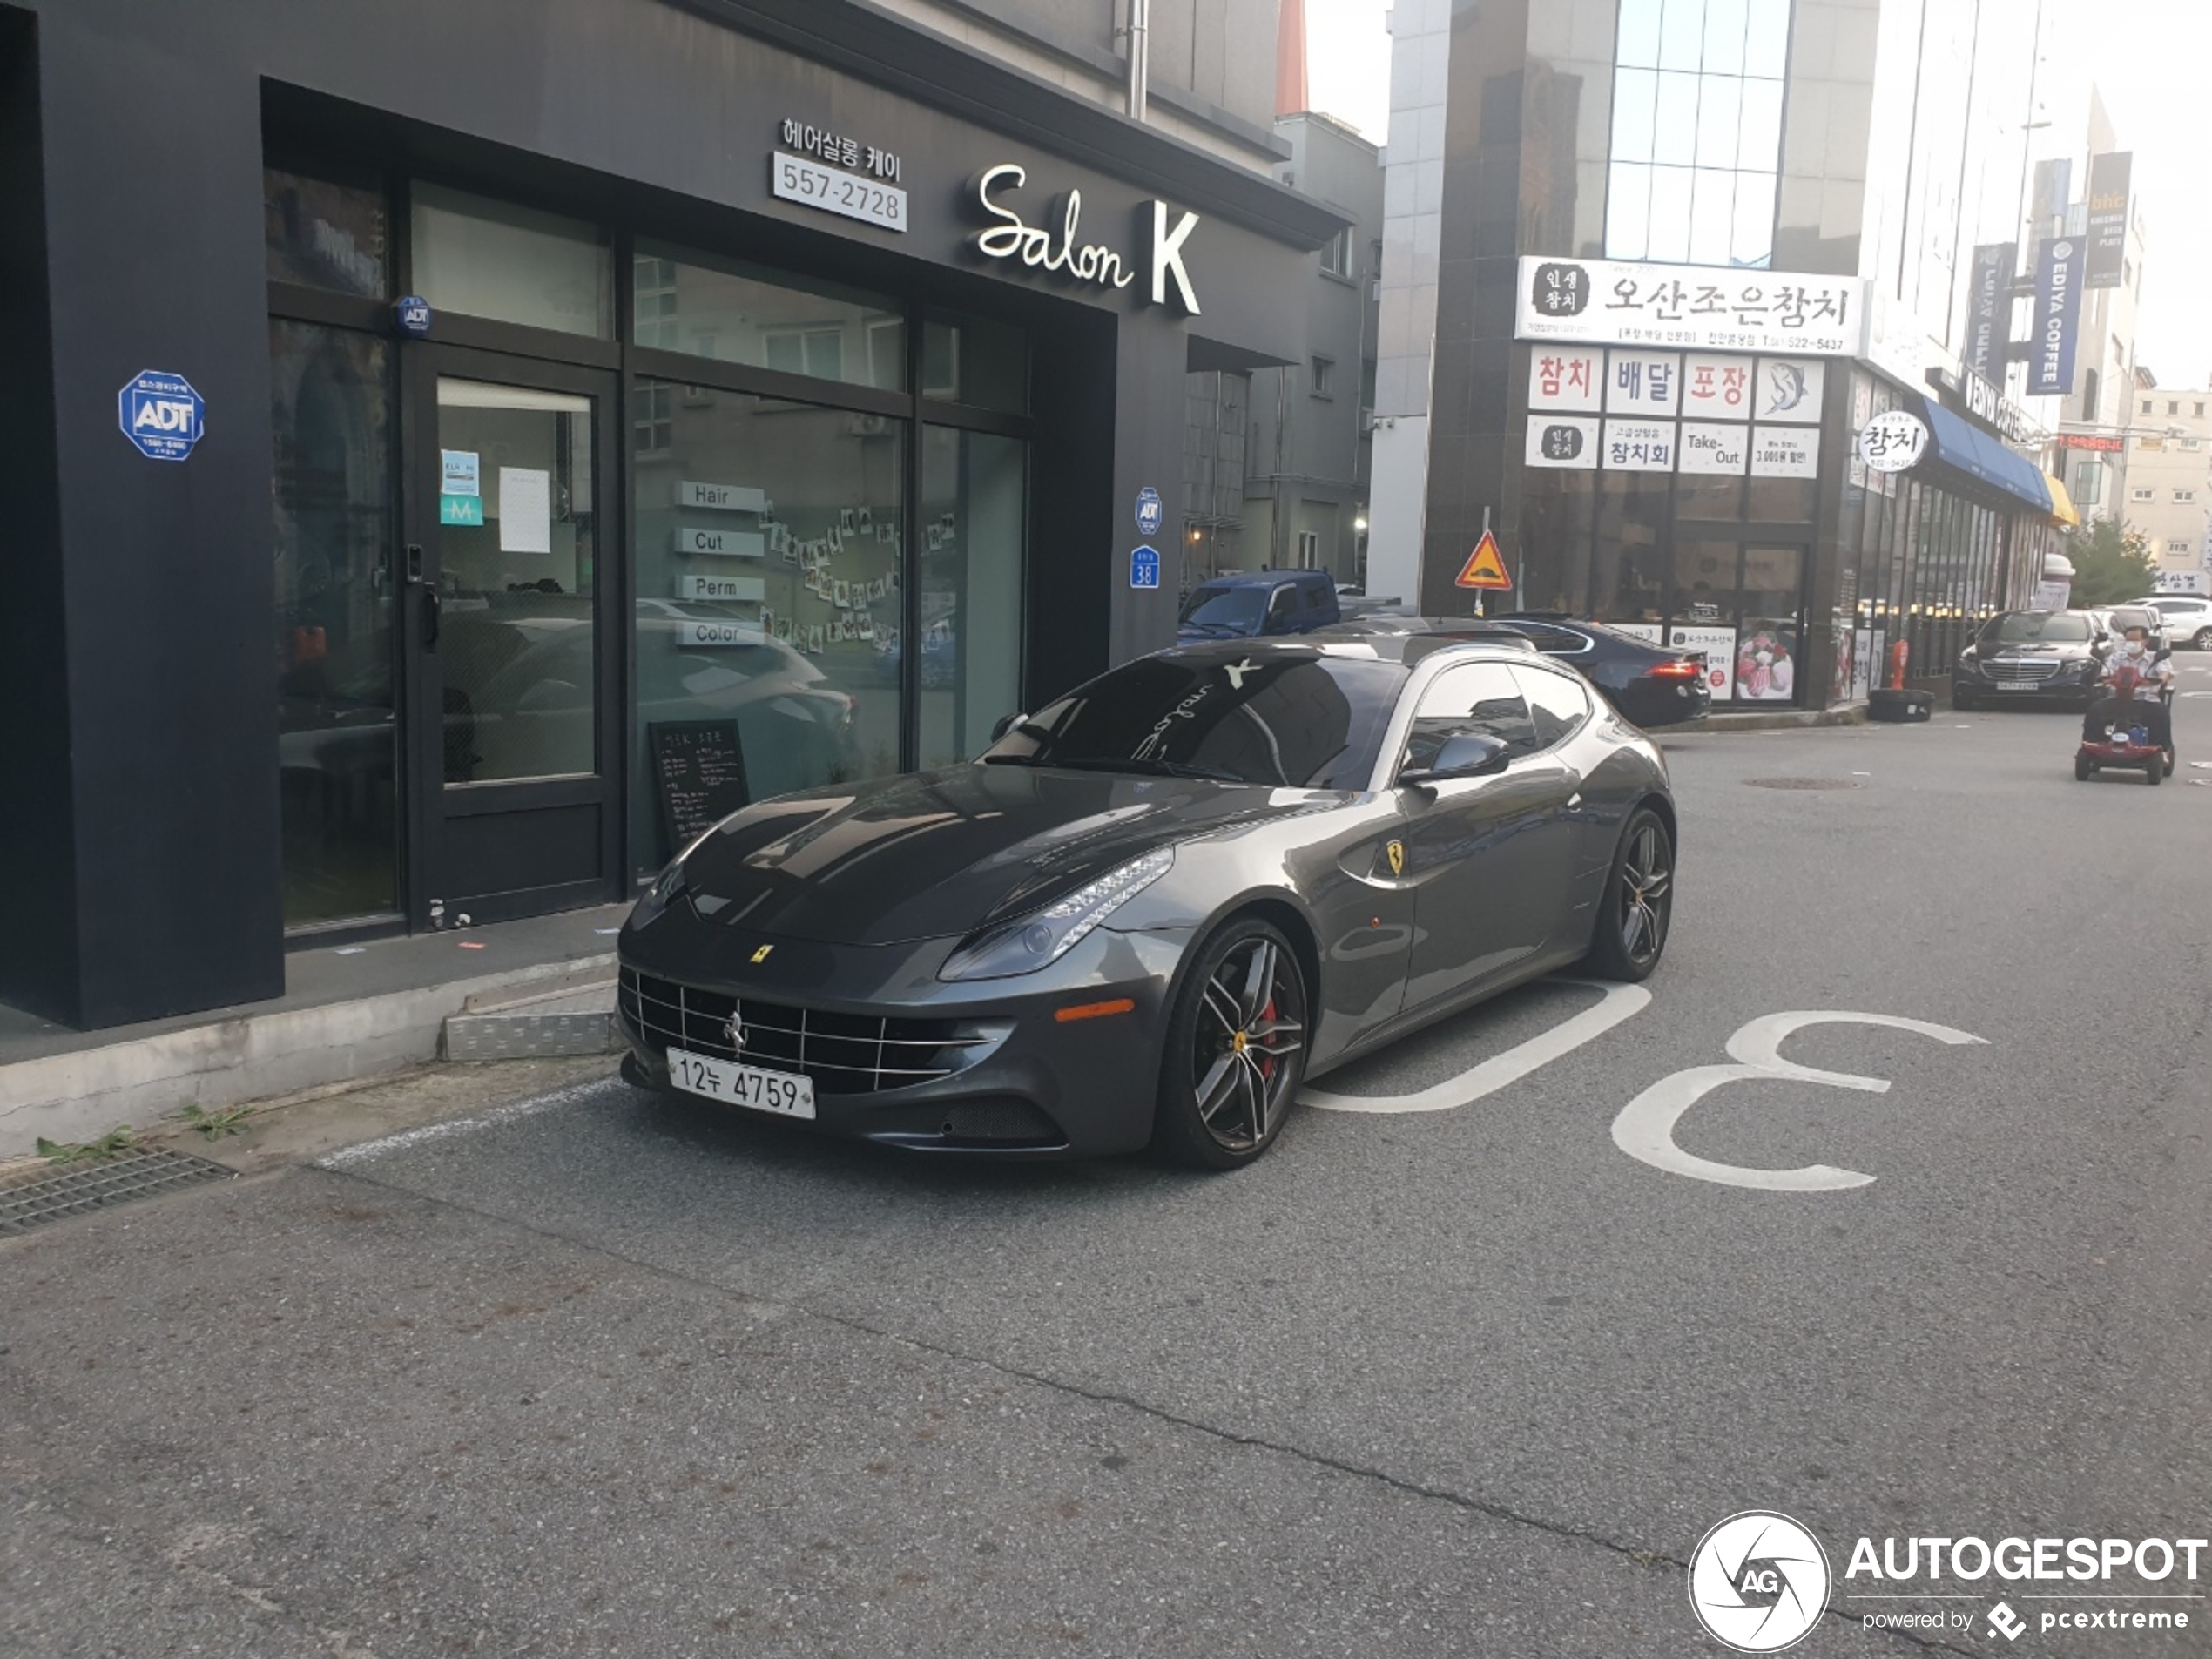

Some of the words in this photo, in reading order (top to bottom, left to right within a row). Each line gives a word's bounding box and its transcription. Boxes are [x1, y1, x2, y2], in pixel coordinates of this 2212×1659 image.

[784, 118, 859, 166] 헤어살롱
[867, 146, 900, 182] 케이
[784, 164, 899, 219] 557-2728
[979, 164, 1135, 287] Salon
[1151, 199, 1202, 315] K
[1545, 291, 1576, 311] 참치
[1605, 278, 1849, 327] 오산조은참치
[2049, 263, 2067, 314] EDIYA
[406, 308, 428, 323] ADT
[2042, 317, 2062, 383] COFFEE
[1539, 356, 1591, 398] 참치
[1618, 361, 1673, 401] 배달
[1691, 366, 1746, 405] 포장
[136, 400, 192, 433] ADT
[1610, 442, 1669, 466] 참치회
[1689, 435, 1723, 449] Take-
[1864, 426, 1920, 457] 참치
[1715, 451, 1740, 464] Out
[696, 484, 730, 504] Hair
[1140, 502, 1158, 520] ADT
[696, 532, 724, 550] Cut
[696, 578, 738, 596] Perm
[1136, 565, 1152, 585] 38
[696, 624, 739, 643] Color
[680, 1057, 722, 1094] 12누
[733, 1071, 798, 1110] 4759
